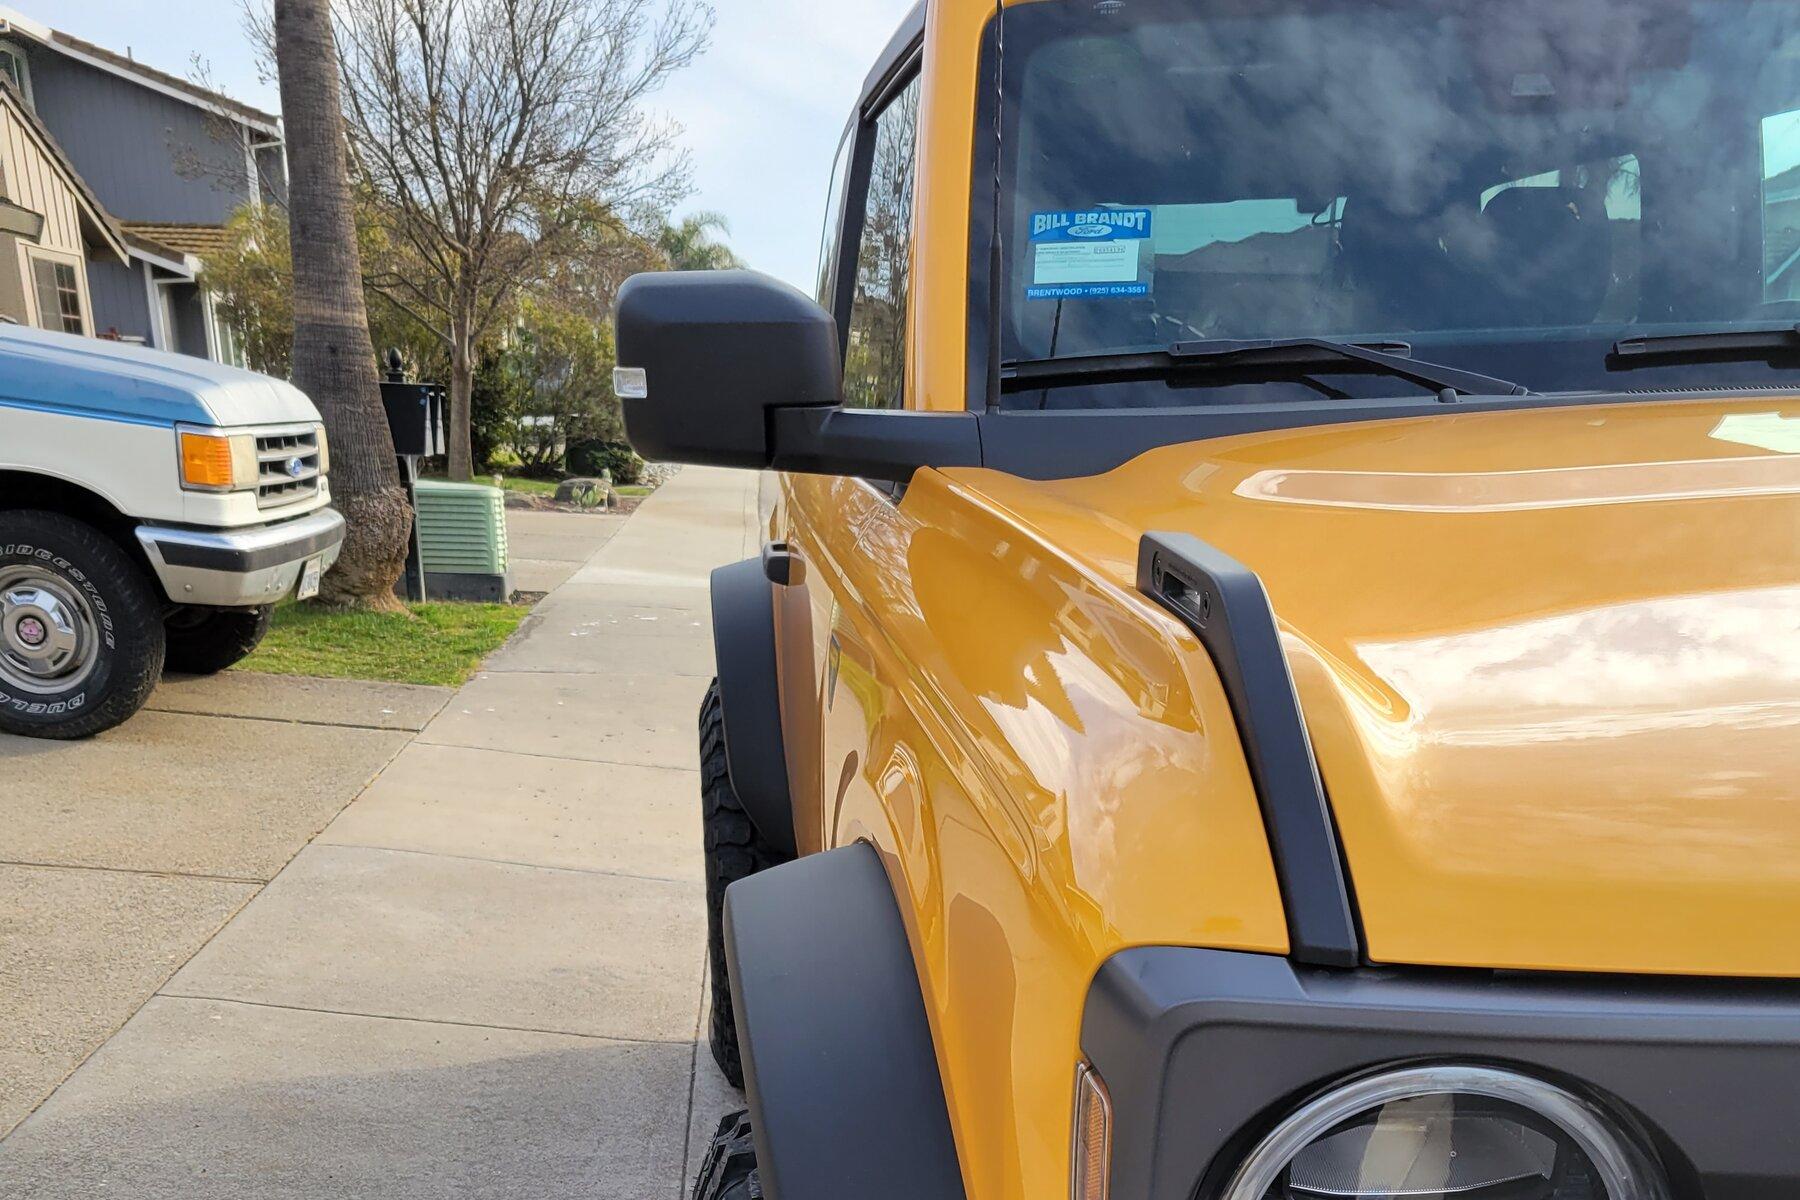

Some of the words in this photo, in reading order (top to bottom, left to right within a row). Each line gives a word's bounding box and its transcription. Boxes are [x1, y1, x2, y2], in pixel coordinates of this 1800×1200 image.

[1033, 214, 1070, 235] BILL
[1075, 211, 1147, 232] BRANDT
[1074, 226, 1104, 235] Ford
[1028, 287, 1083, 298] BRENTWOOD
[1089, 287, 1109, 296] (925)
